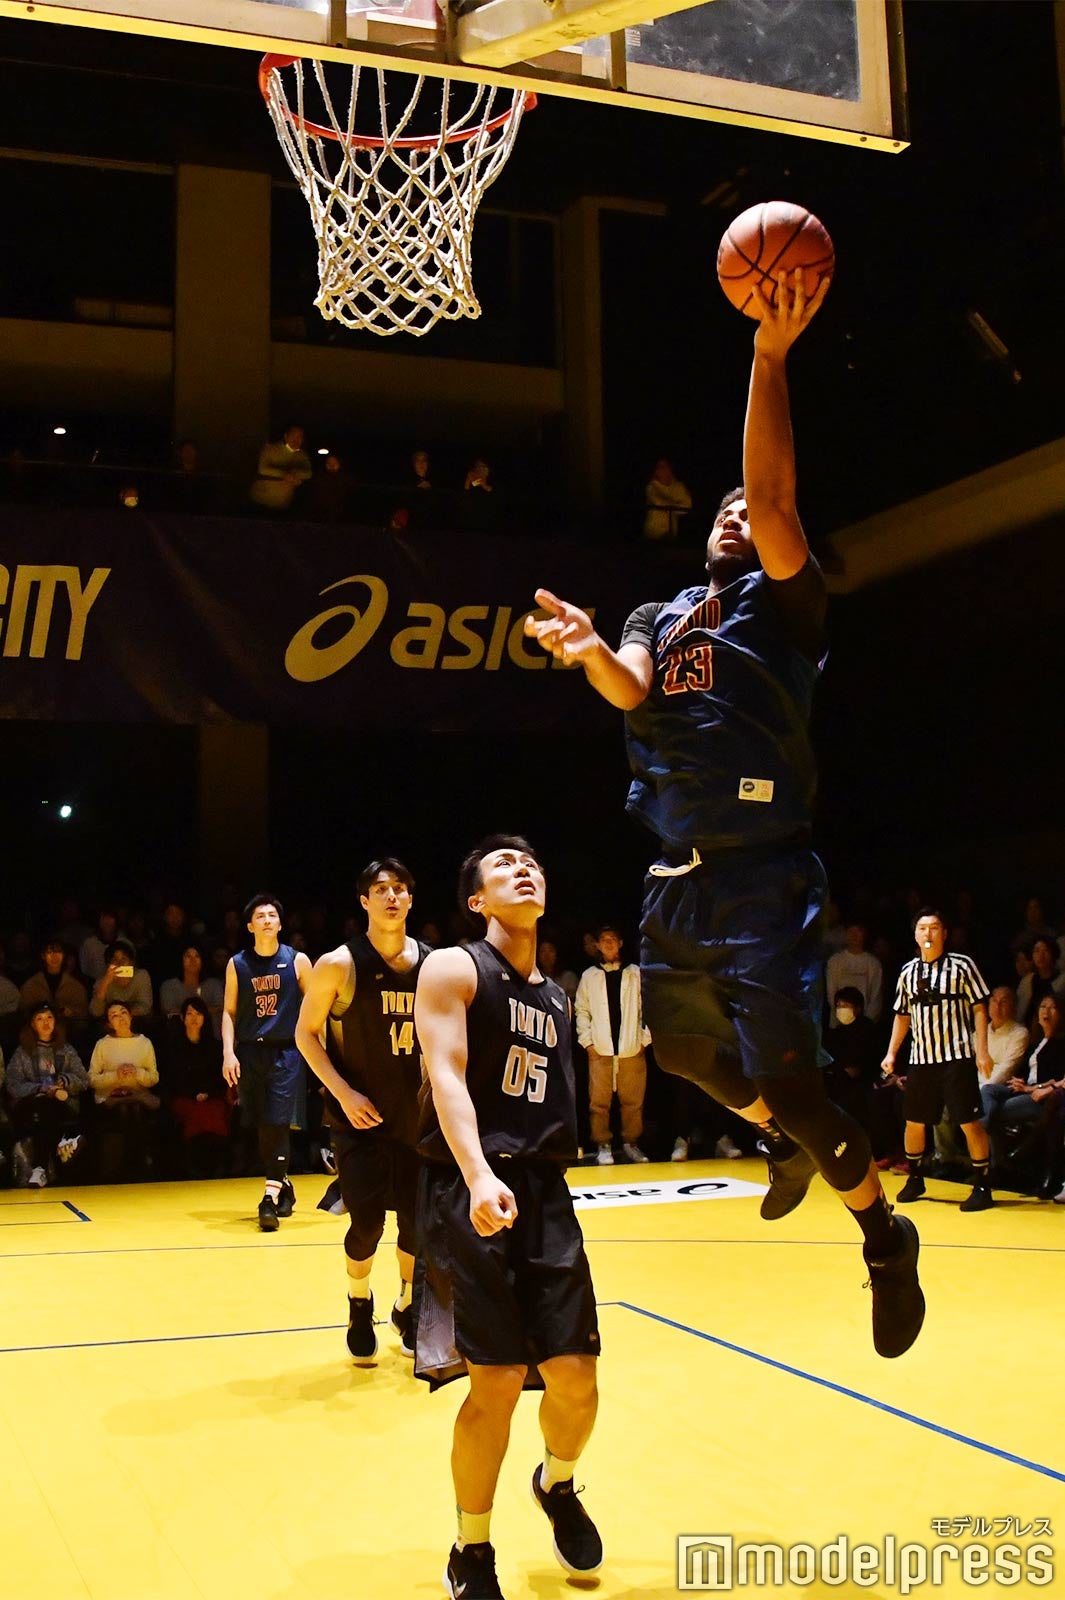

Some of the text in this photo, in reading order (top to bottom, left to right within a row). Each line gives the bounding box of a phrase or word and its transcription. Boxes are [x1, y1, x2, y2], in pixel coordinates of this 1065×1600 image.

[661, 640, 714, 696] 23
[251, 973, 281, 993] TOKYO
[255, 993, 278, 1018] 32
[380, 990, 415, 1015] TOKY
[389, 1021, 415, 1056] 14
[508, 997, 558, 1049] TOKYO
[501, 1044, 549, 1104] 05
